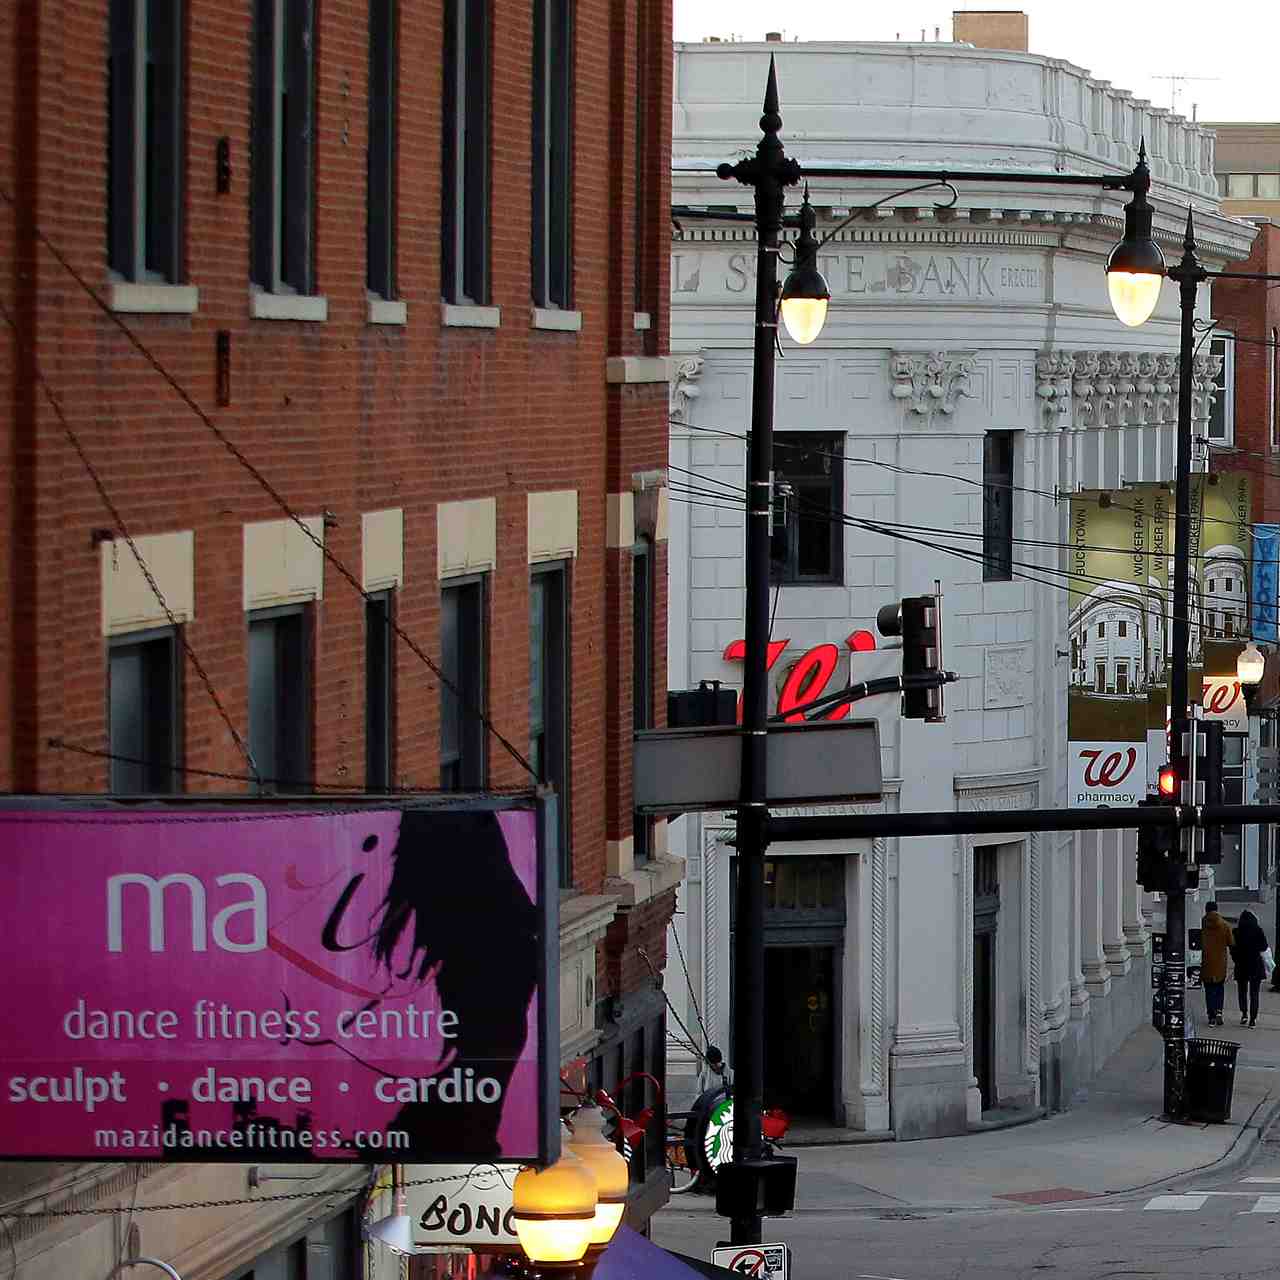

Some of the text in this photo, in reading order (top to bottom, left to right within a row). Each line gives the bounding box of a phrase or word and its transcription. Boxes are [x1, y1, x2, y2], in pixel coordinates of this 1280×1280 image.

[896, 254, 995, 296] BANK
[1074, 508, 1087, 576] BUCKTOWN
[1134, 498, 1144, 577] WICKER PARK
[1153, 495, 1164, 571] WICKER PARK
[1077, 792, 1136, 804] pharmacy
[63, 1000, 460, 1040] dance fitness centre
[9, 1066, 503, 1112] sculpt dance cardio
[95, 1124, 410, 1149] mazidancefitness.com
